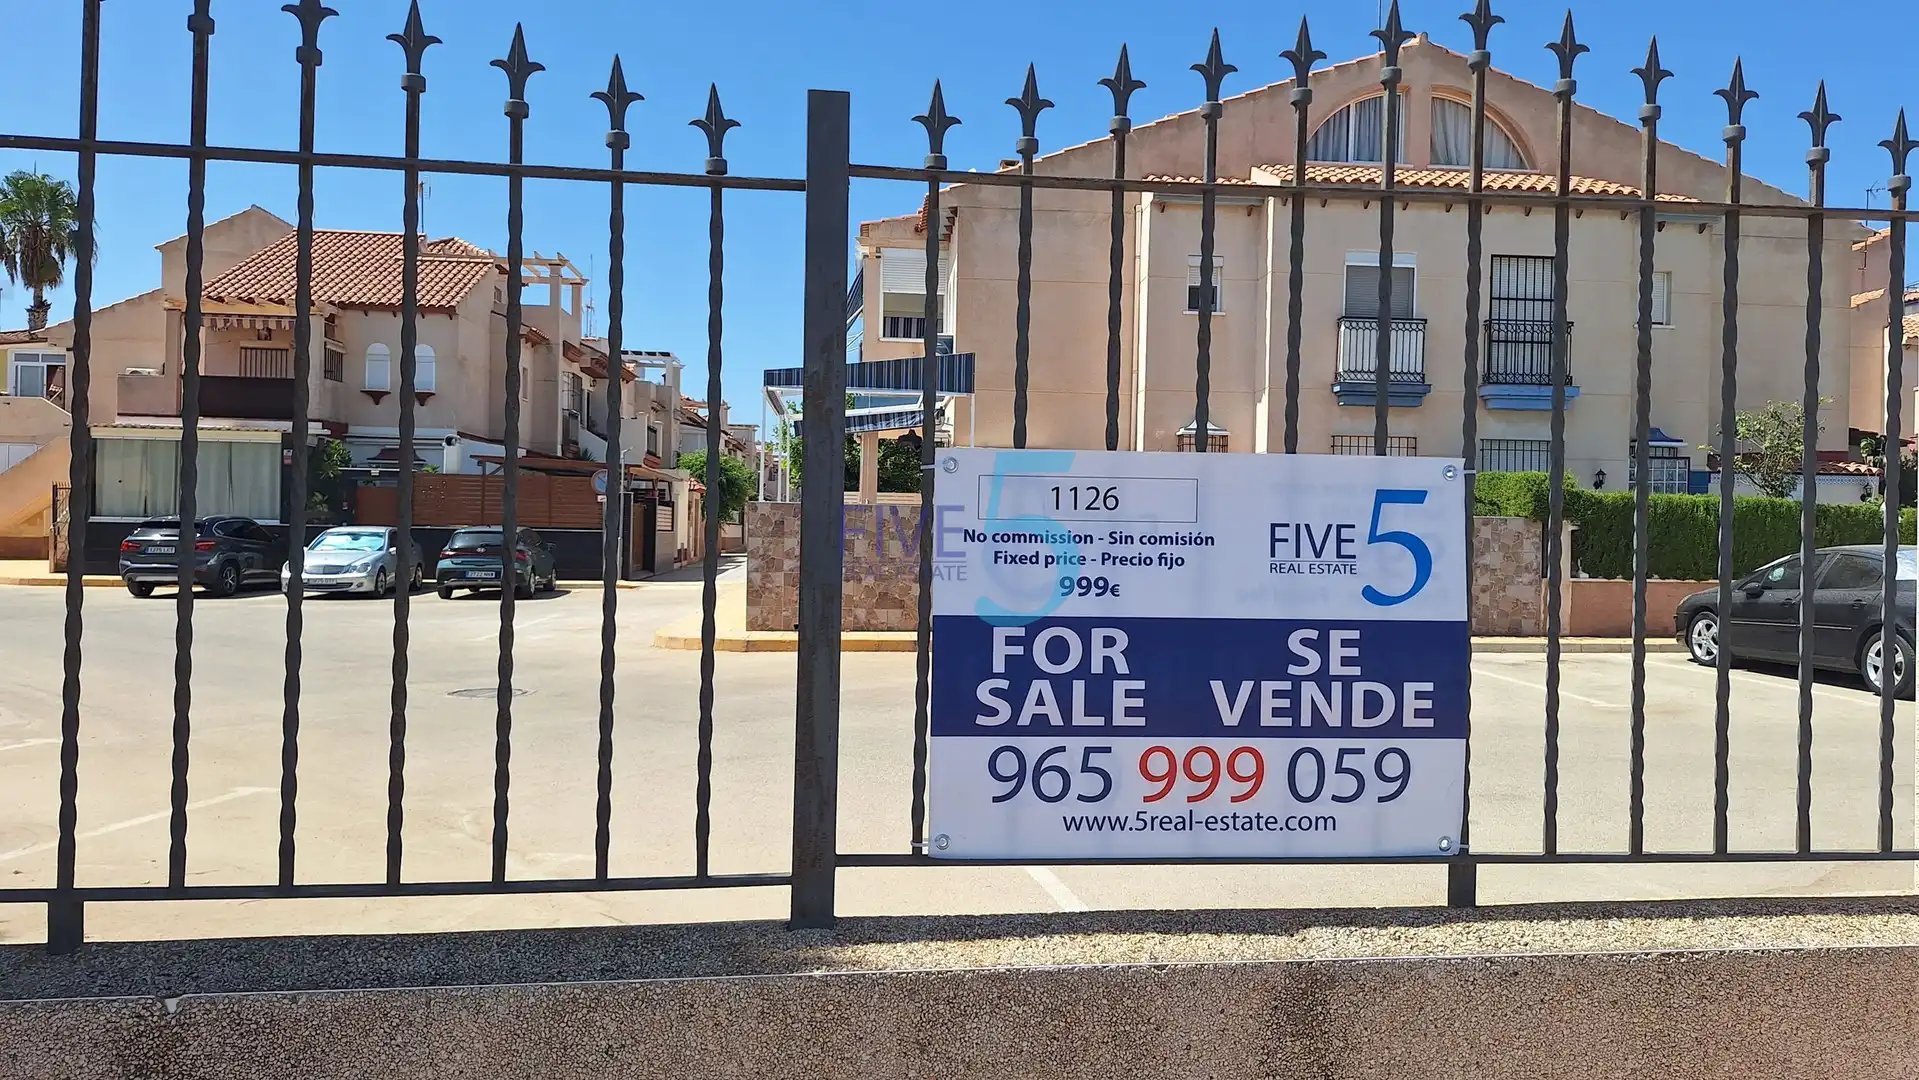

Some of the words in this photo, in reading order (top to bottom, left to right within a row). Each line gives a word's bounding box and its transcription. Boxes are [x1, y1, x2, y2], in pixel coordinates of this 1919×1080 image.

[1051, 485, 1120, 511] 1126
[963, 528, 988, 543] No
[991, 529, 1094, 545] commission
[1108, 530, 1135, 545] Sin
[1138, 531, 1215, 547] comisión
[1270, 522, 1357, 559] FIVE
[1361, 488, 1433, 607] 5
[993, 550, 1040, 565] Fixed
[1044, 551, 1087, 569] price
[1101, 551, 1154, 567] Precio
[1157, 551, 1185, 571] fijo
[1269, 562, 1305, 574] REAL
[1308, 563, 1358, 575] ESTATE
[1059, 575, 1121, 598] 999€
[992, 626, 1130, 675] FOR
[1287, 628, 1362, 676] SE
[975, 678, 1146, 727] SALE
[1209, 680, 1435, 728] VENDE
[987, 745, 1113, 804] 965
[1138, 745, 1265, 804] 999
[1287, 746, 1411, 804] 059
[1062, 809, 1337, 832] www.5real-estate.com
